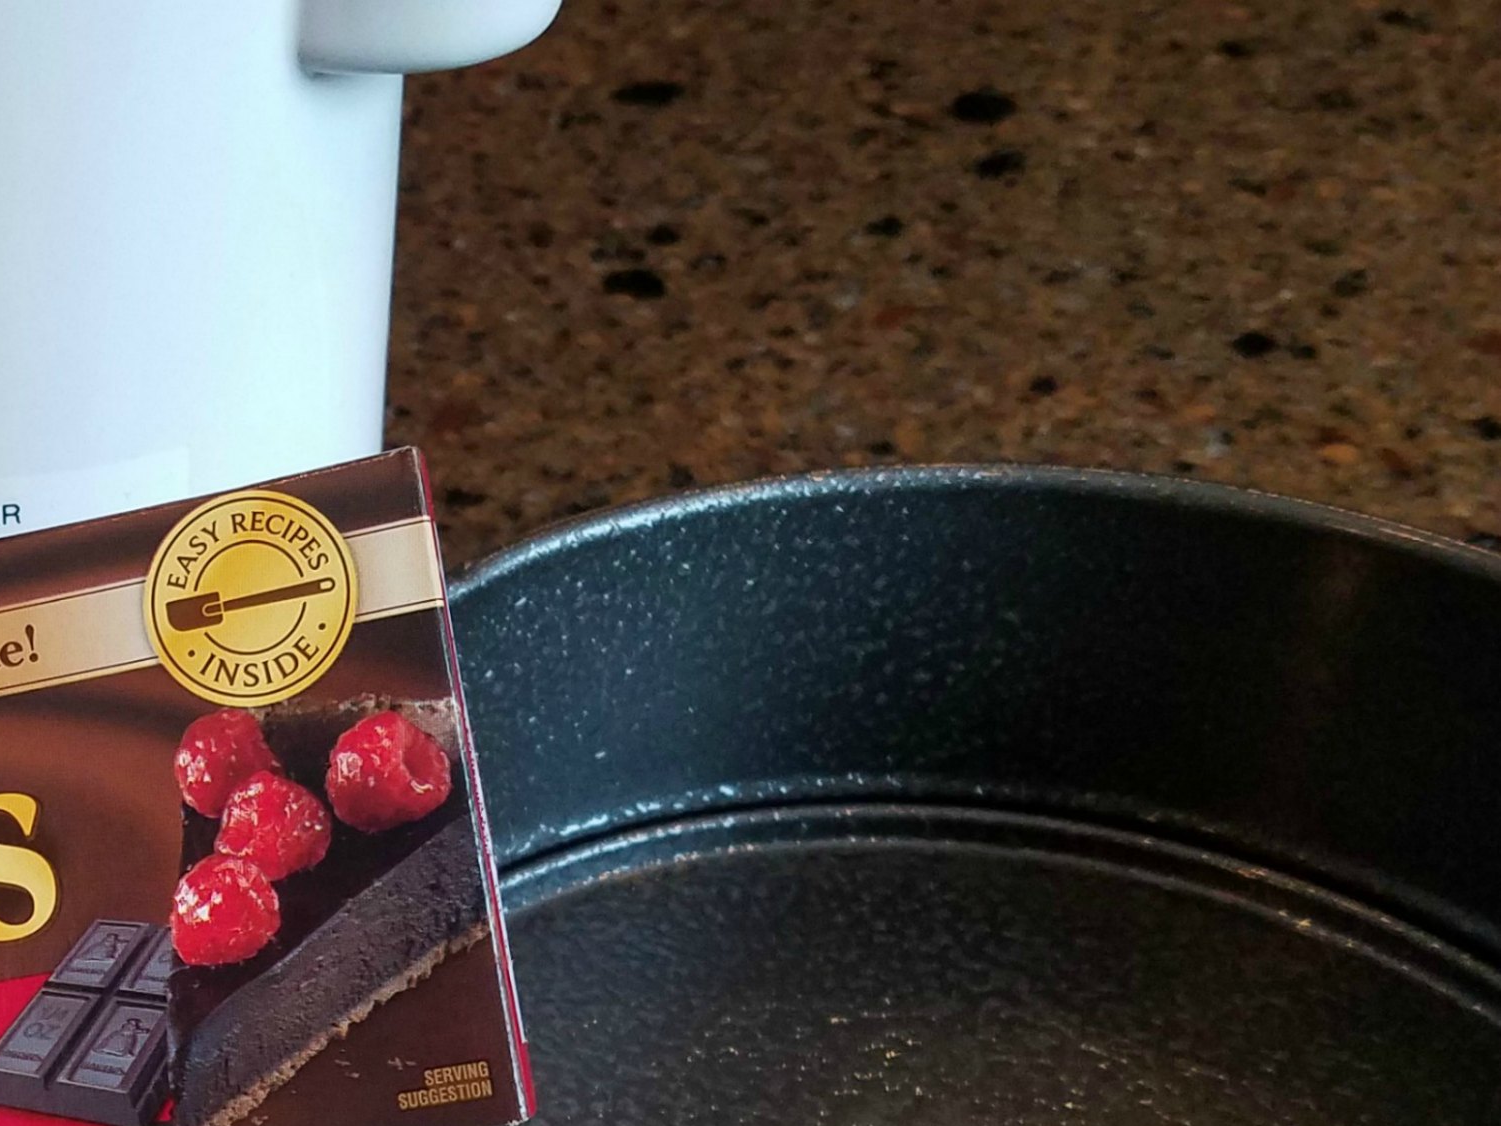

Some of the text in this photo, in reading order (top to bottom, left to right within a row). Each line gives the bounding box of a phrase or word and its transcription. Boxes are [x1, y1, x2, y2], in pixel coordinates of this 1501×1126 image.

[166, 510, 331, 591] EASY RECIPES
[199, 634, 321, 688] INSIDE
[424, 1060, 490, 1086] SERVING
[397, 1079, 493, 1111] SUGGESTION
